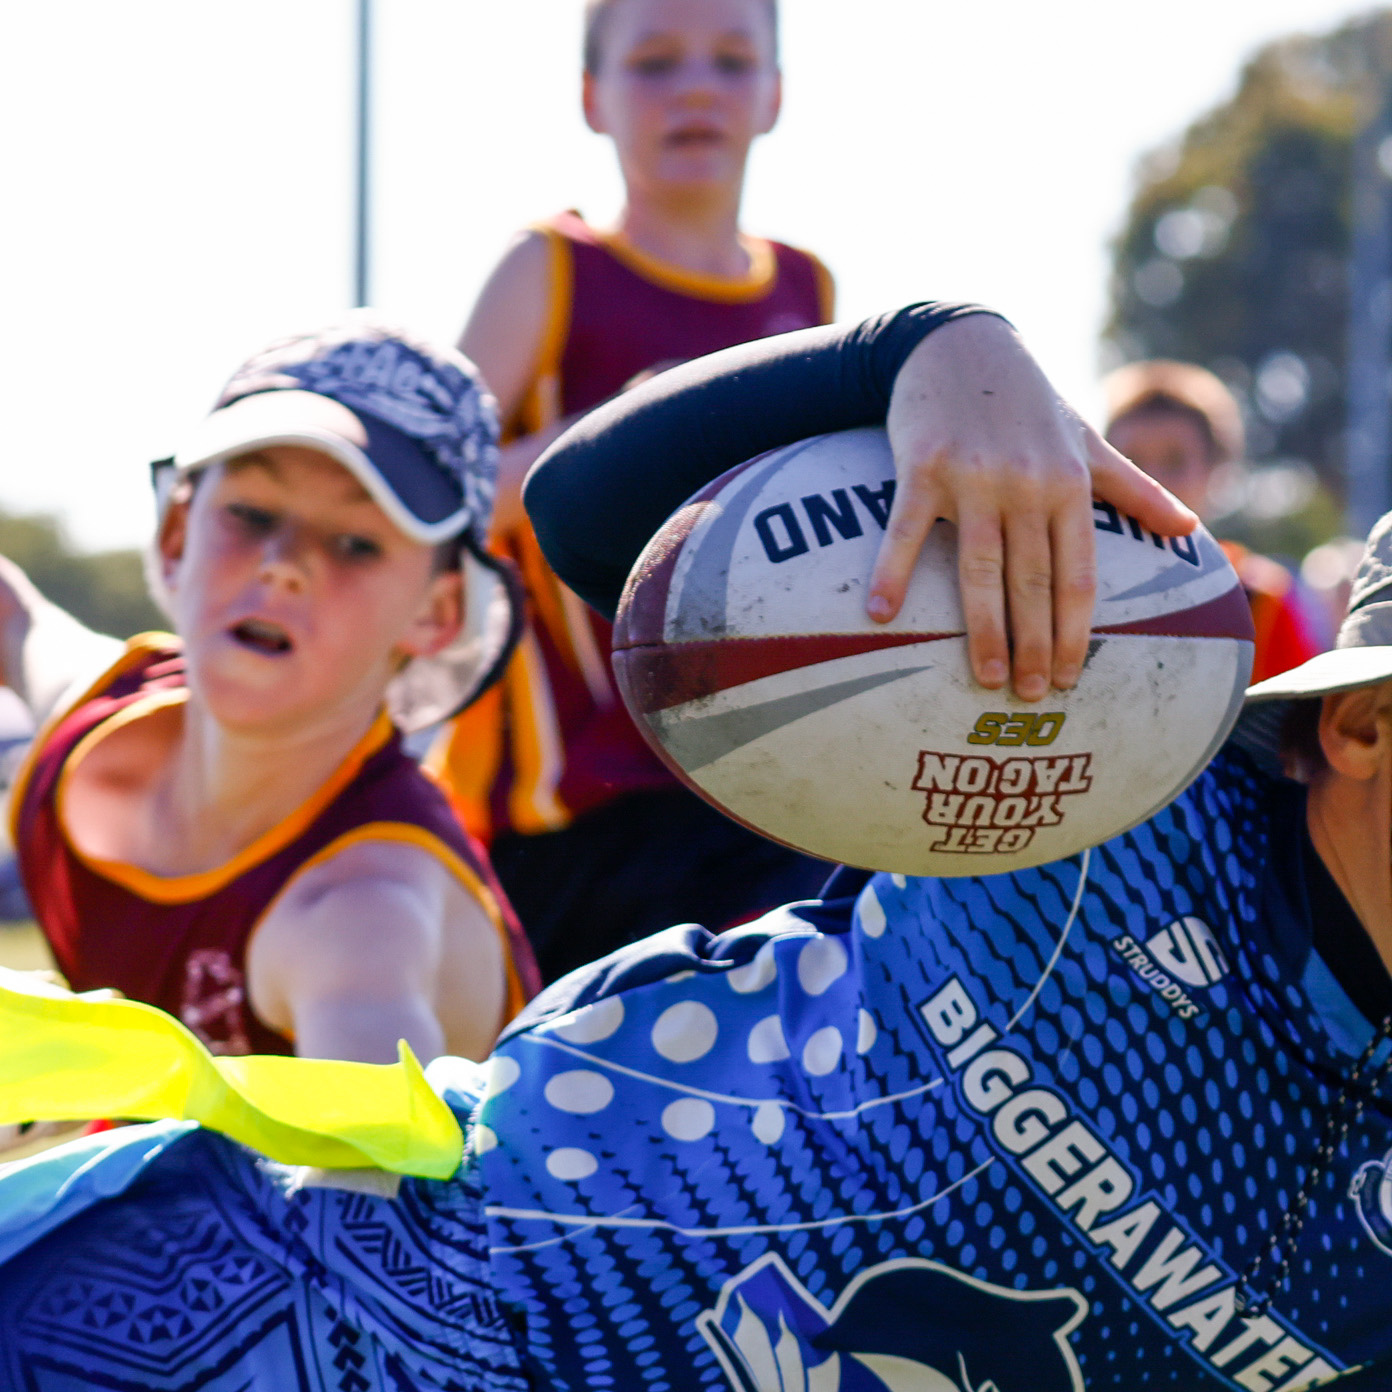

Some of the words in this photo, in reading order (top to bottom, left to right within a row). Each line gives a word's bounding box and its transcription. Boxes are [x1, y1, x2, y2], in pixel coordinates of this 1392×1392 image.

[911, 750, 994, 794] ON
[997, 752, 1093, 796] TAG
[922, 792, 1065, 828] YOUR
[929, 827, 1036, 854] GET
[1113, 935, 1199, 1019] STRUDDYS
